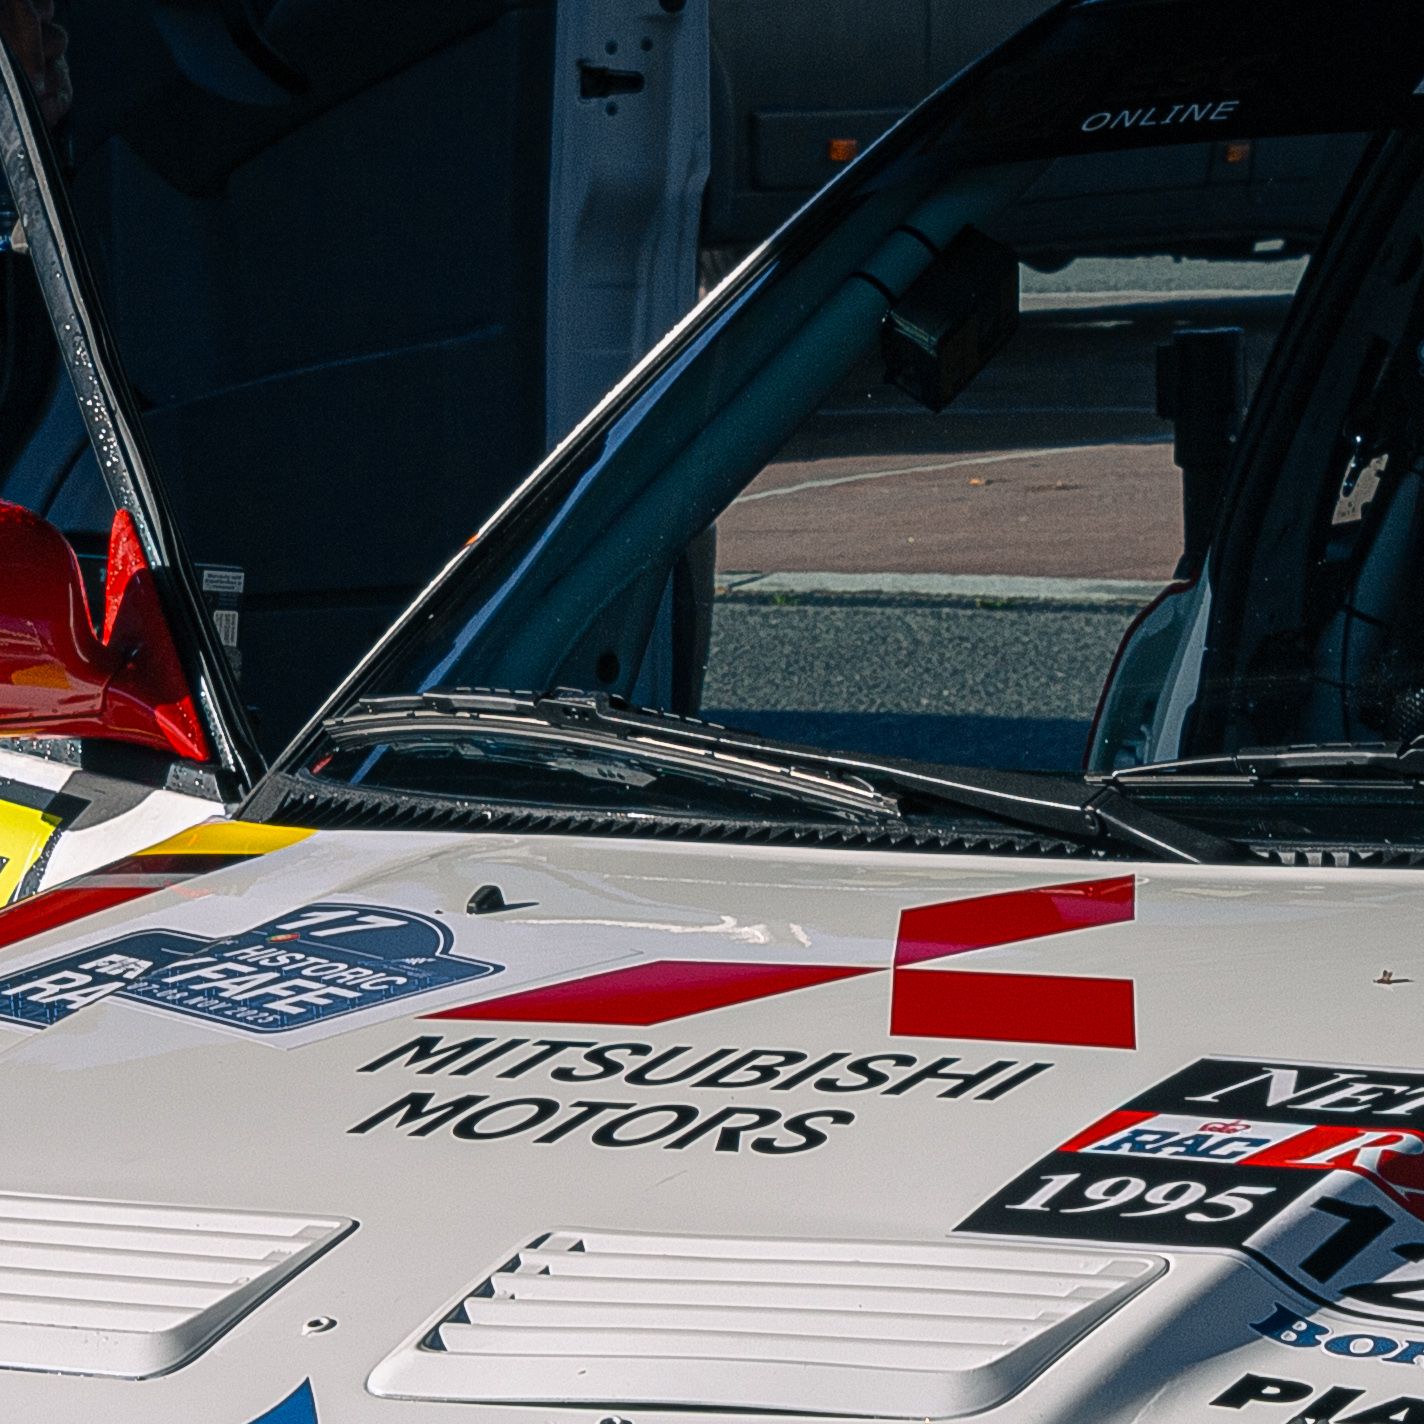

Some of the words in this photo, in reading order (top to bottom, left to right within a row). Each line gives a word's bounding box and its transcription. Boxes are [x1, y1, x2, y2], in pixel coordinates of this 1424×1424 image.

[1080, 99, 1240, 133] ONLINE
[277, 908, 409, 938] 17
[222, 944, 407, 990] HISTORIC
[356, 1033, 1055, 1102] MITSUBISHI
[346, 1091, 857, 1155] MOTORS
[1098, 1126, 1270, 1163] RAC
[1005, 1170, 1278, 1223] 1995
